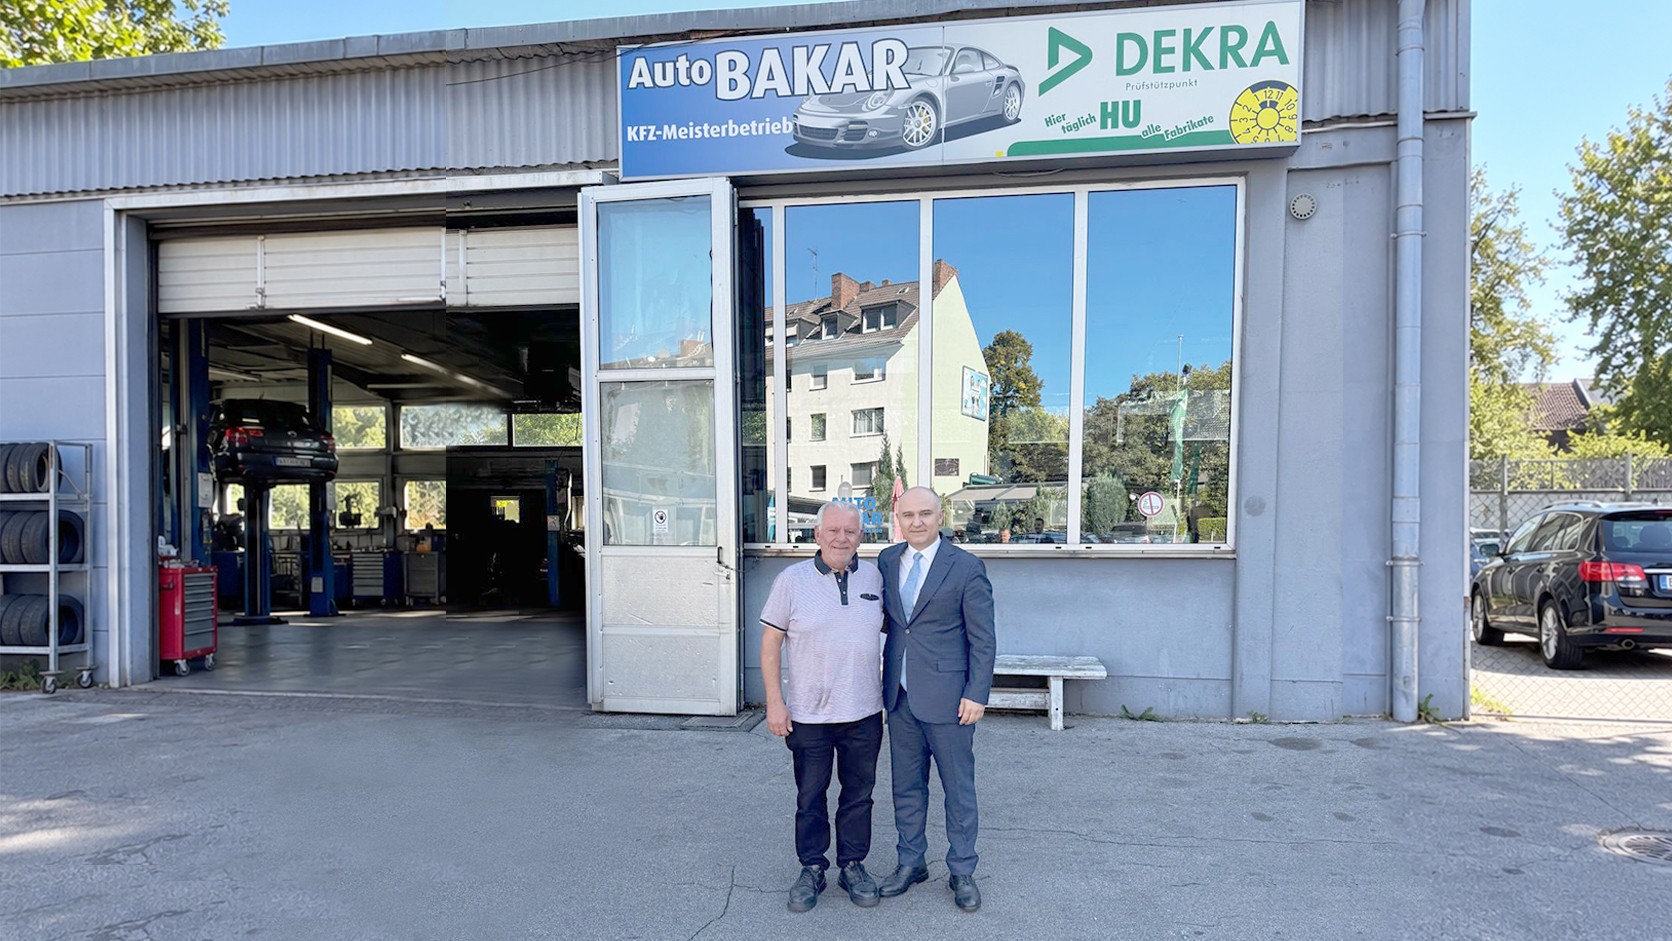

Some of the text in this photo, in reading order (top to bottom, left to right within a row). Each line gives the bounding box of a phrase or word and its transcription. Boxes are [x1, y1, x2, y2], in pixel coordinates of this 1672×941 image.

[1116, 20, 1290, 76] DEKRA
[628, 38, 912, 101] Auto BAKAR
[1125, 79, 1198, 91] Prüfstützpunkt
[1264, 90, 1274, 99] 12
[627, 117, 793, 142] KFZ-Meisterbetrieb
[1044, 99, 1215, 141] Hier täglich HU alle Fabrikate
